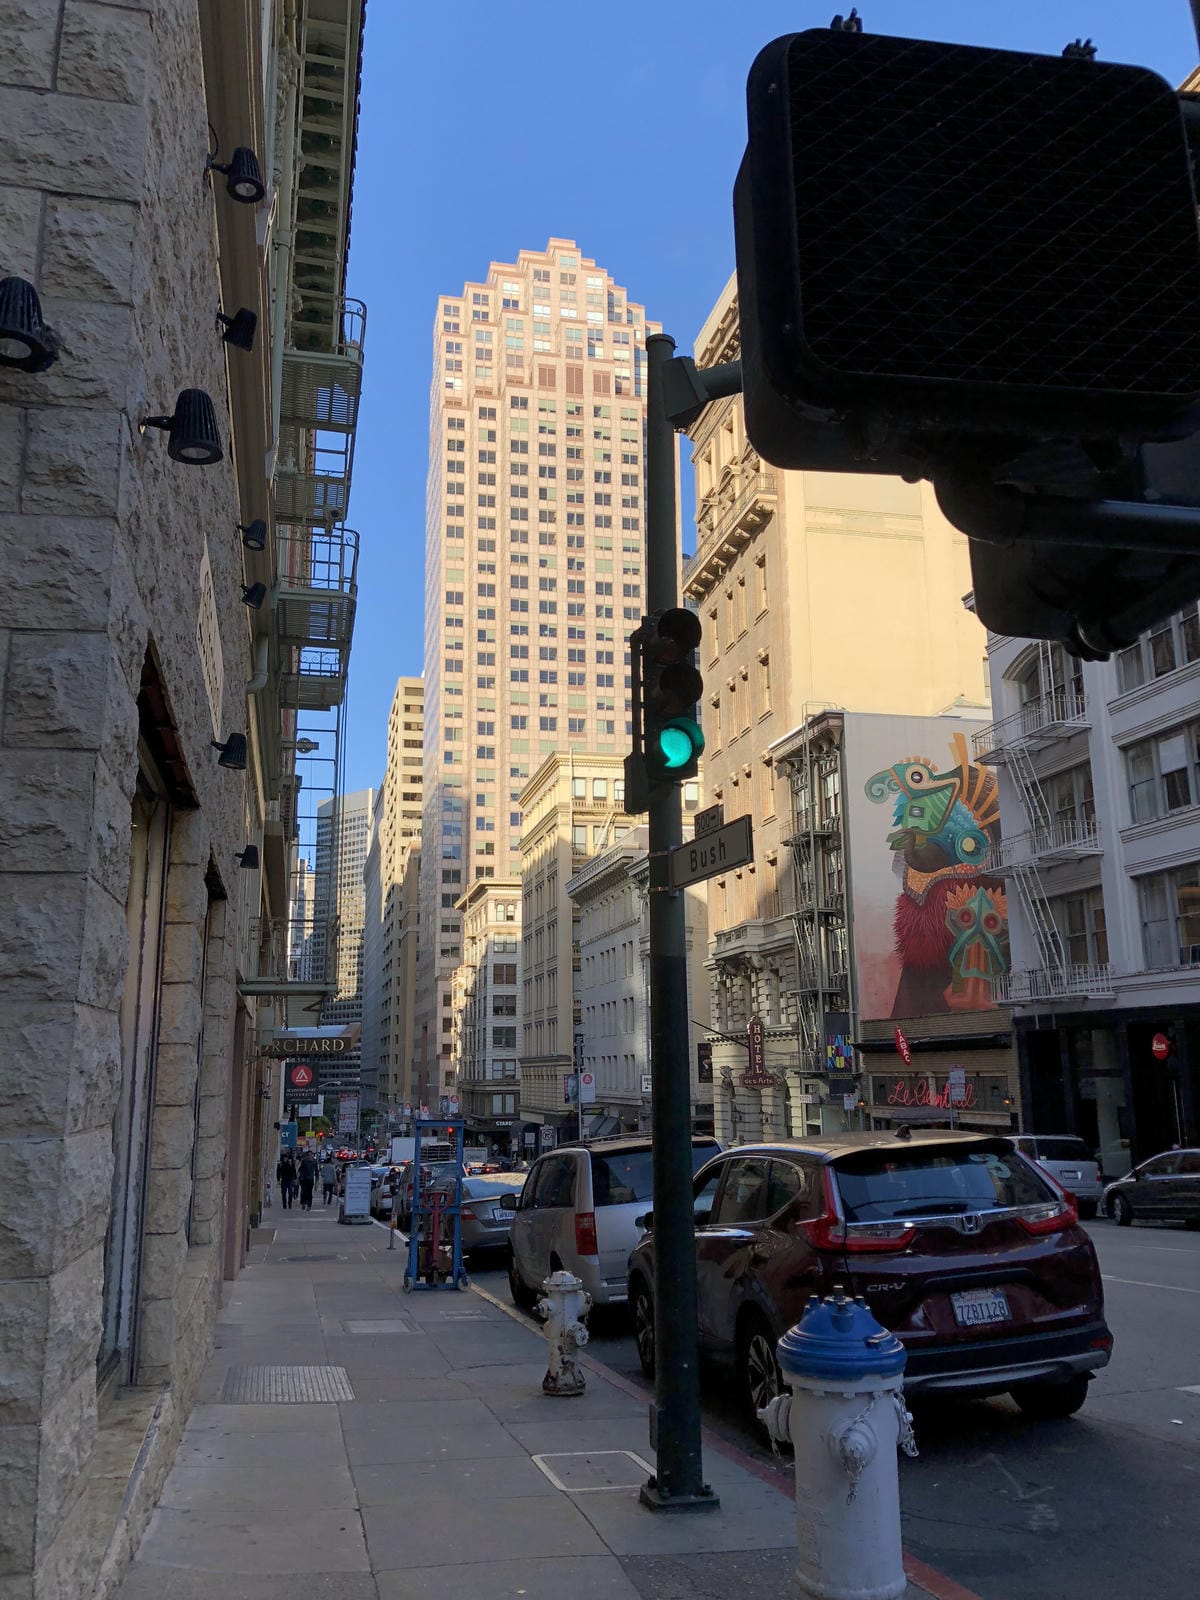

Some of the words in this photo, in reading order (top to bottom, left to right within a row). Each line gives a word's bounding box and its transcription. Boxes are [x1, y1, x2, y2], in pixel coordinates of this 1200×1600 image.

[690, 838, 726, 872] Bush
[753, 1024, 763, 1074] HOTEL
[896, 1028, 911, 1062] TABAC
[743, 1077, 757, 1085] des
[758, 1077, 774, 1085] Arts
[888, 1080, 914, 1105] Le
[866, 1281, 907, 1292] CR-V
